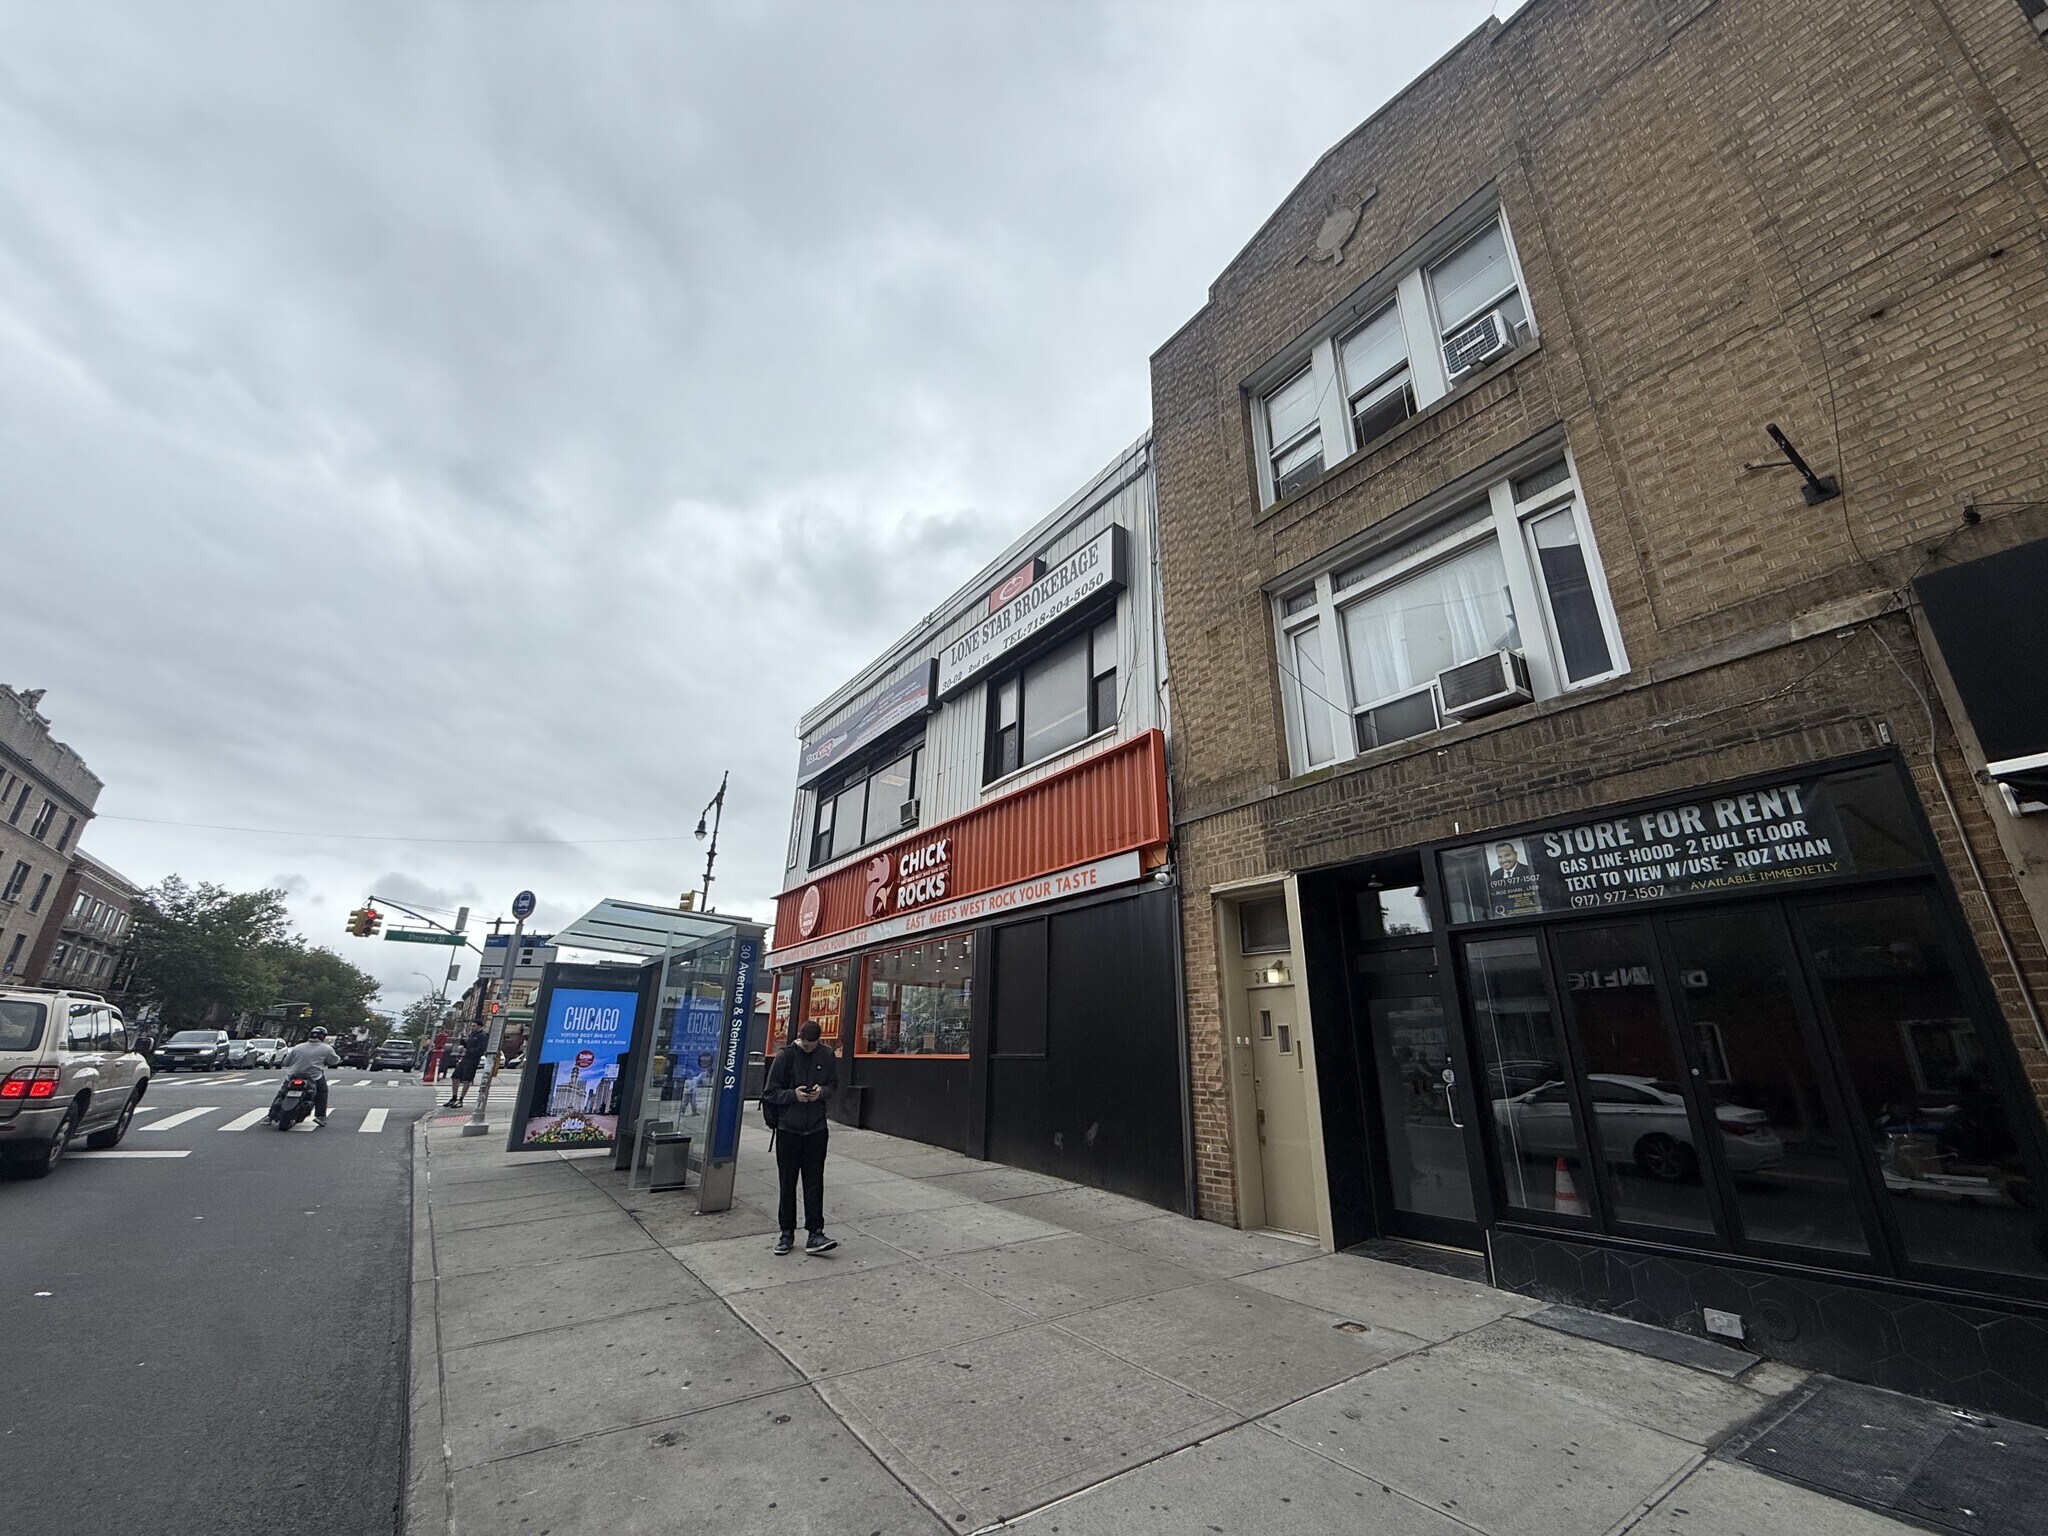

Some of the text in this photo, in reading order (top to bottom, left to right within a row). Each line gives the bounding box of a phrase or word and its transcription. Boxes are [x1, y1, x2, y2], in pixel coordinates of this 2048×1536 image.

[950, 632, 980, 666] LONE
[982, 613, 1012, 644] STAR
[1014, 542, 1099, 622] BROKERAGE
[942, 671, 962, 692] 30-02
[968, 659, 980, 674] 2nd
[1003, 572, 1104, 650] TEL:718-204-5050
[1543, 784, 1803, 858] STORE FOR RENT
[900, 839, 946, 876] CHICK
[1560, 820, 1809, 874] GAS LINE-HOOD- 2 FULL FLOOR
[1565, 838, 1832, 892] TEXT TO VIEW W/USE- ROZ KHAN
[898, 872, 945, 908] ROCKS
[1490, 874, 1540, 888] (917) 977-1507
[1570, 885, 1665, 908] (917) 977-1507
[1690, 862, 1838, 890] AVAILABLE IMMEDIETLY
[906, 869, 1096, 931] EAST MEETS WEST ROCK YOUR TASTE
[848, 931, 868, 947] TASTE
[564, 1006, 620, 1032] CHICAGO
[724, 944, 752, 1090] 30 Avenue & Steinway St
